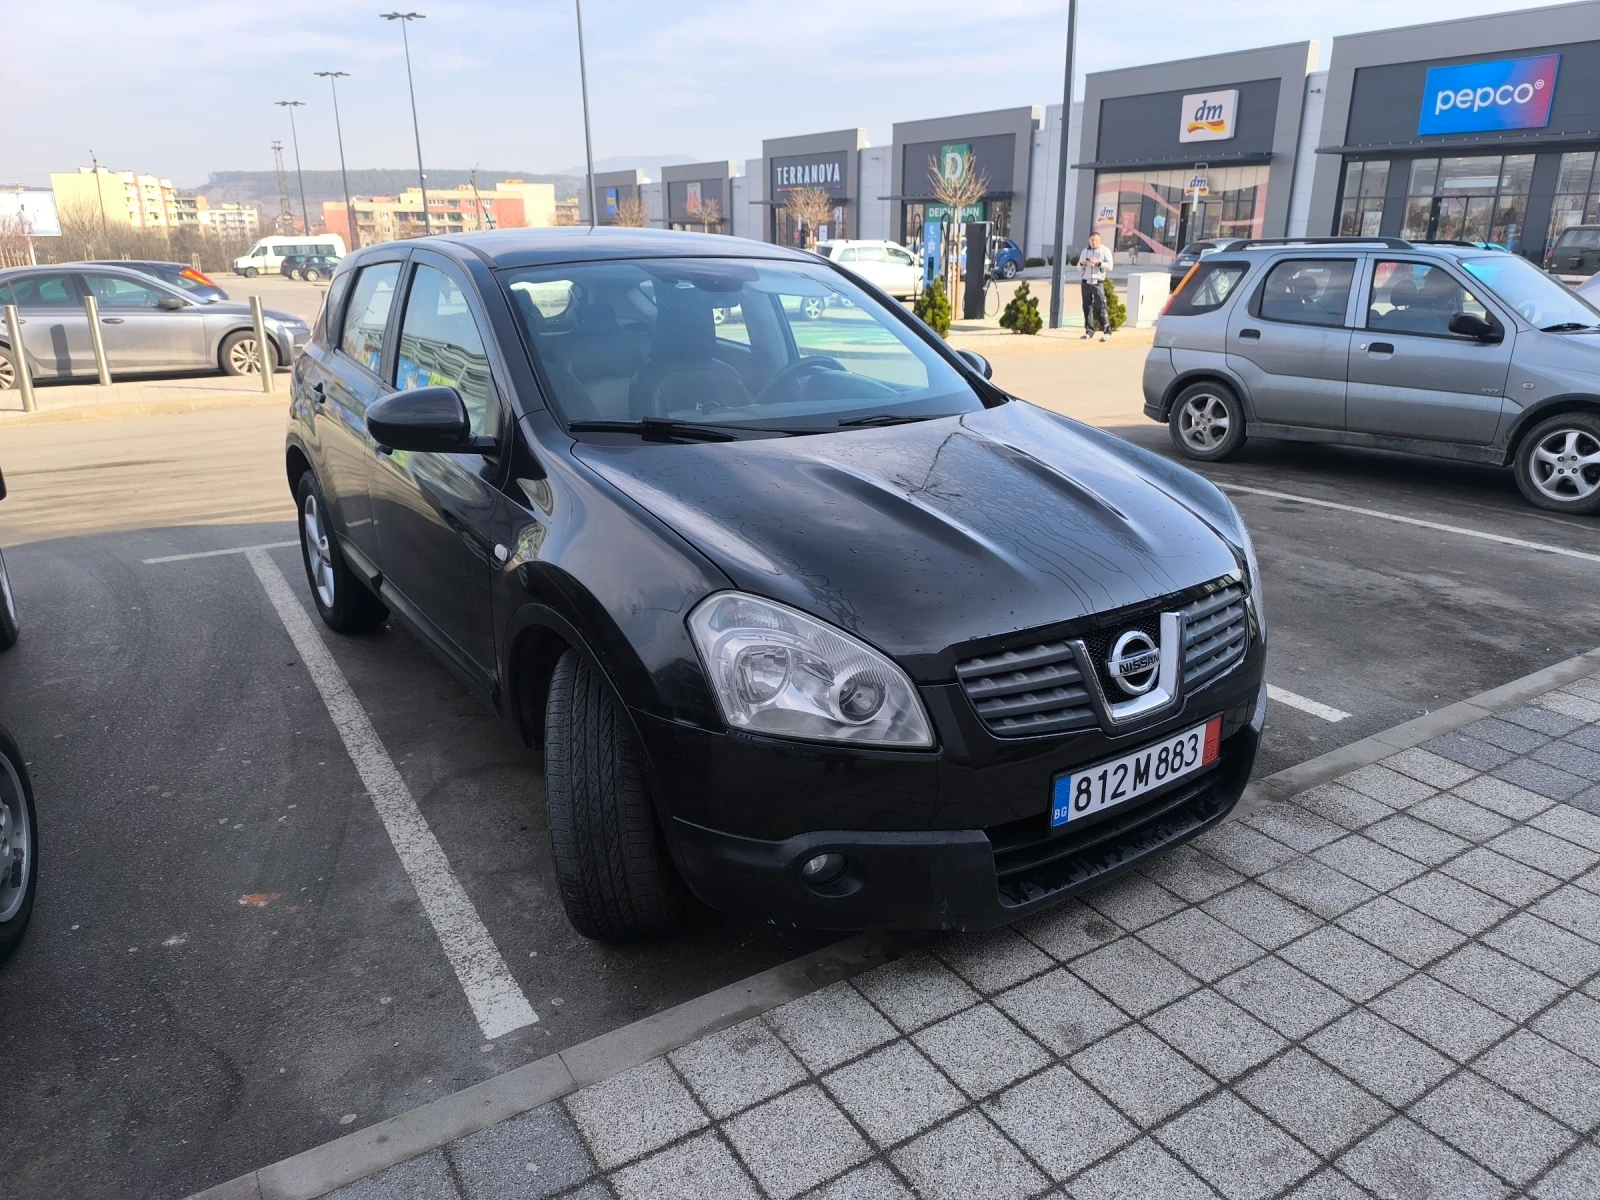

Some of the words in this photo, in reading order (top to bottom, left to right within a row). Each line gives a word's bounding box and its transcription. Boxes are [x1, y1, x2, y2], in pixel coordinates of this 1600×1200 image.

[1435, 83, 1534, 115] pepco
[1195, 100, 1223, 121] dm
[776, 163, 840, 185] TERRANOVA
[1190, 175, 1206, 188] dm
[928, 206, 980, 217] DEICHANN
[1100, 205, 1113, 216] dm
[1118, 651, 1160, 674] NISSAN
[1054, 806, 1068, 820] BG
